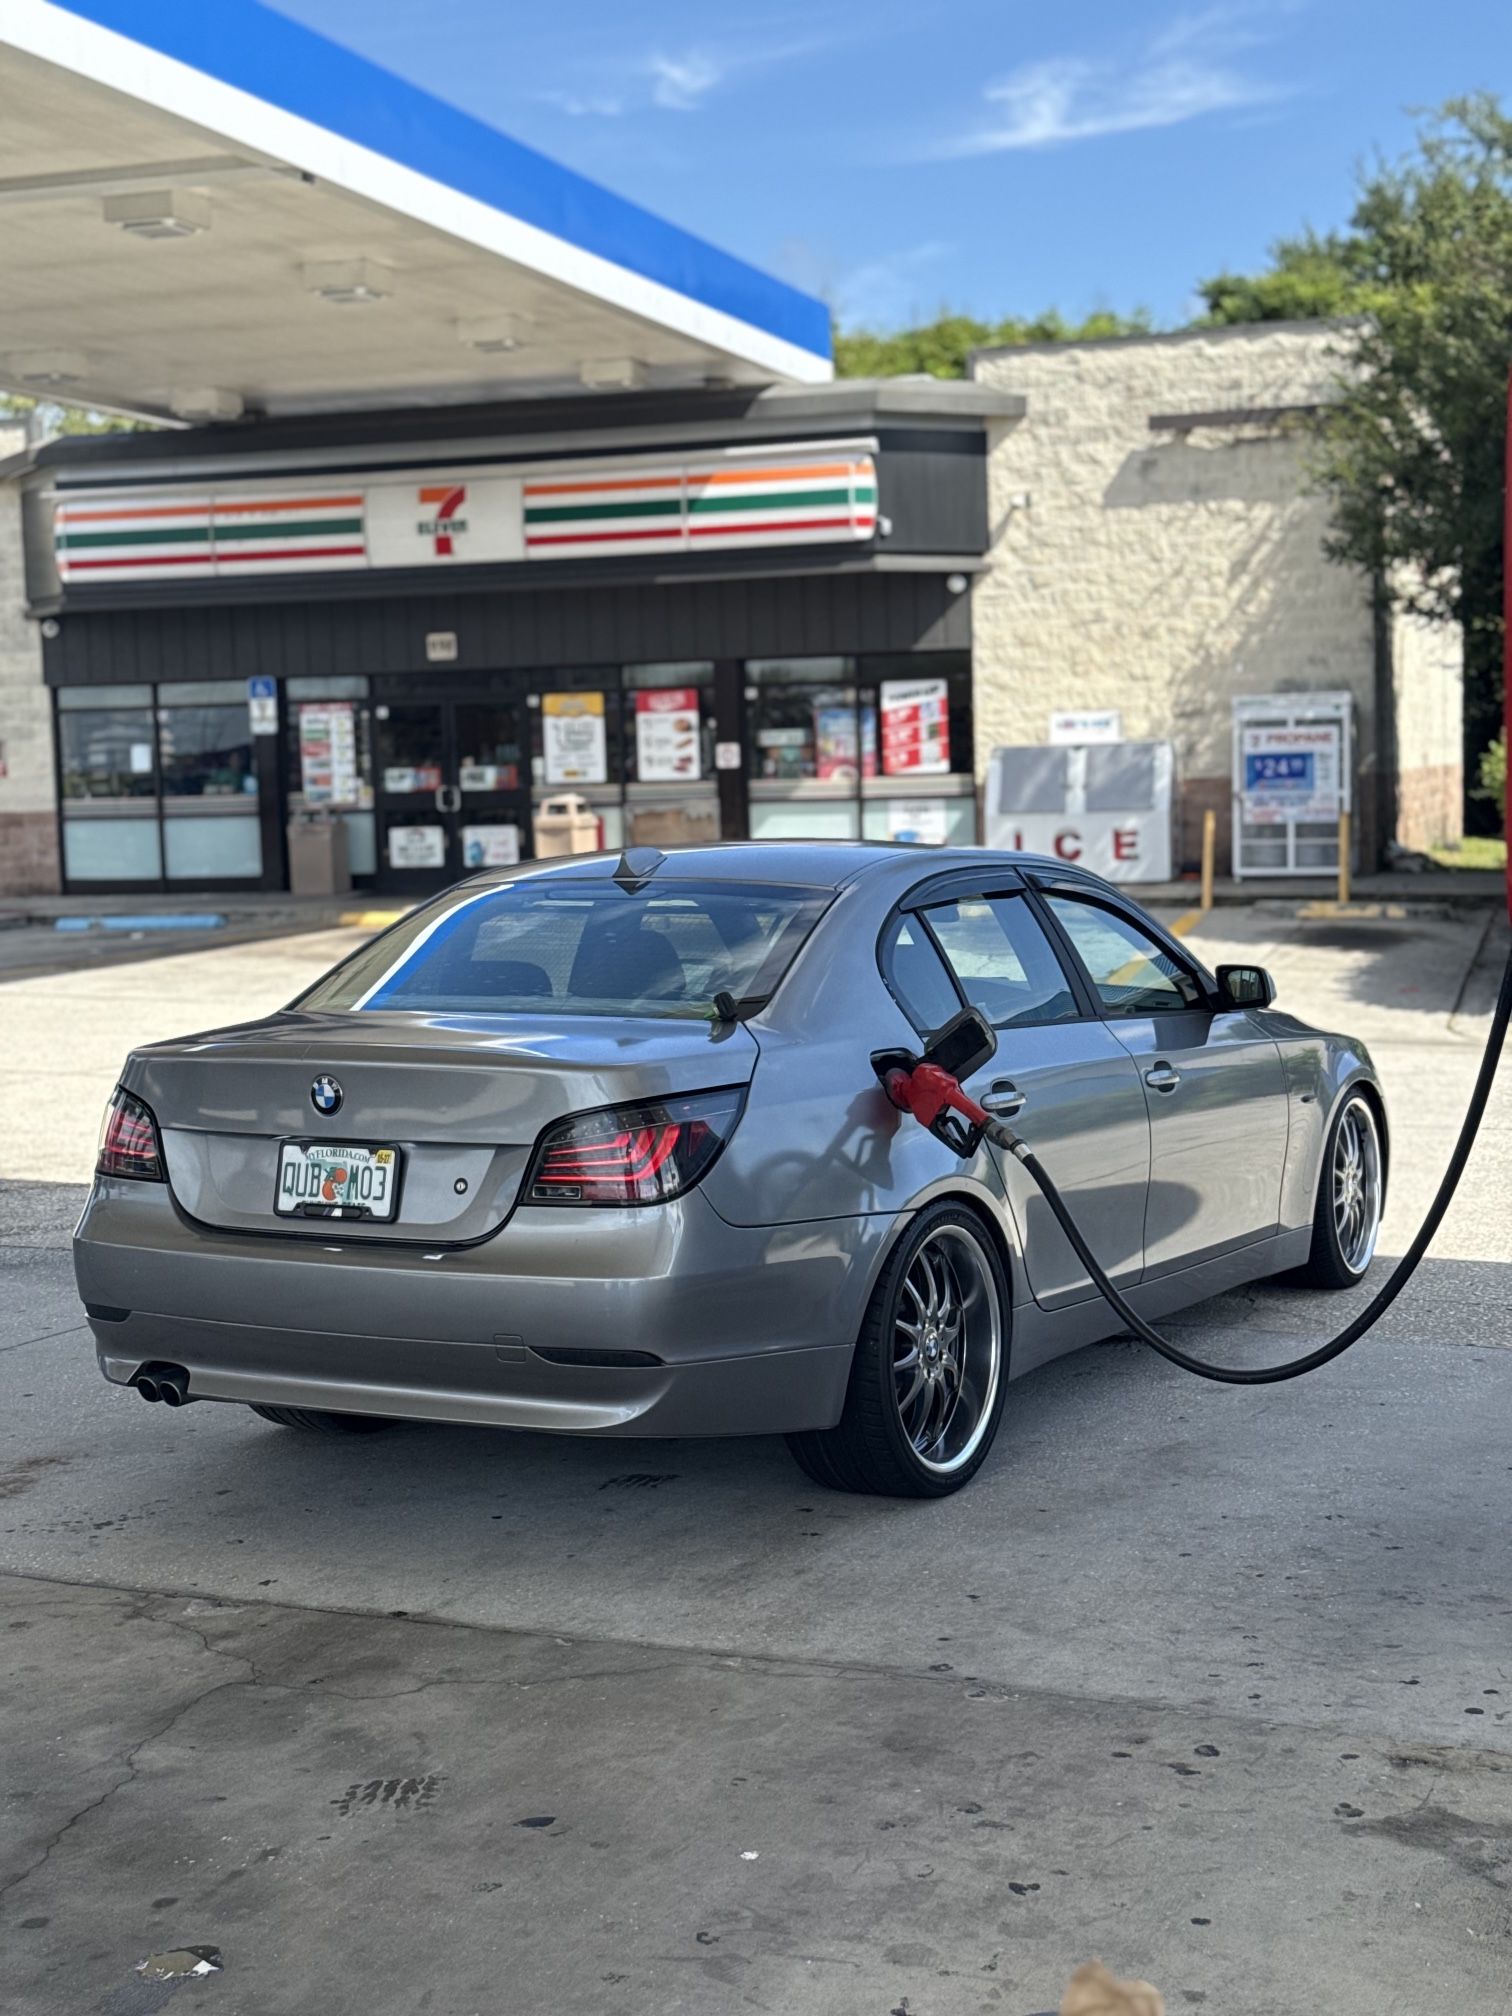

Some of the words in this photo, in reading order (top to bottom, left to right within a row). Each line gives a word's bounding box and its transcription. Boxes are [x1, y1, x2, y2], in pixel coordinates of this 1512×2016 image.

[418, 487, 466, 556] 7
[1265, 732, 1333, 744] PROPANE
[282, 1161, 323, 1198] QUB
